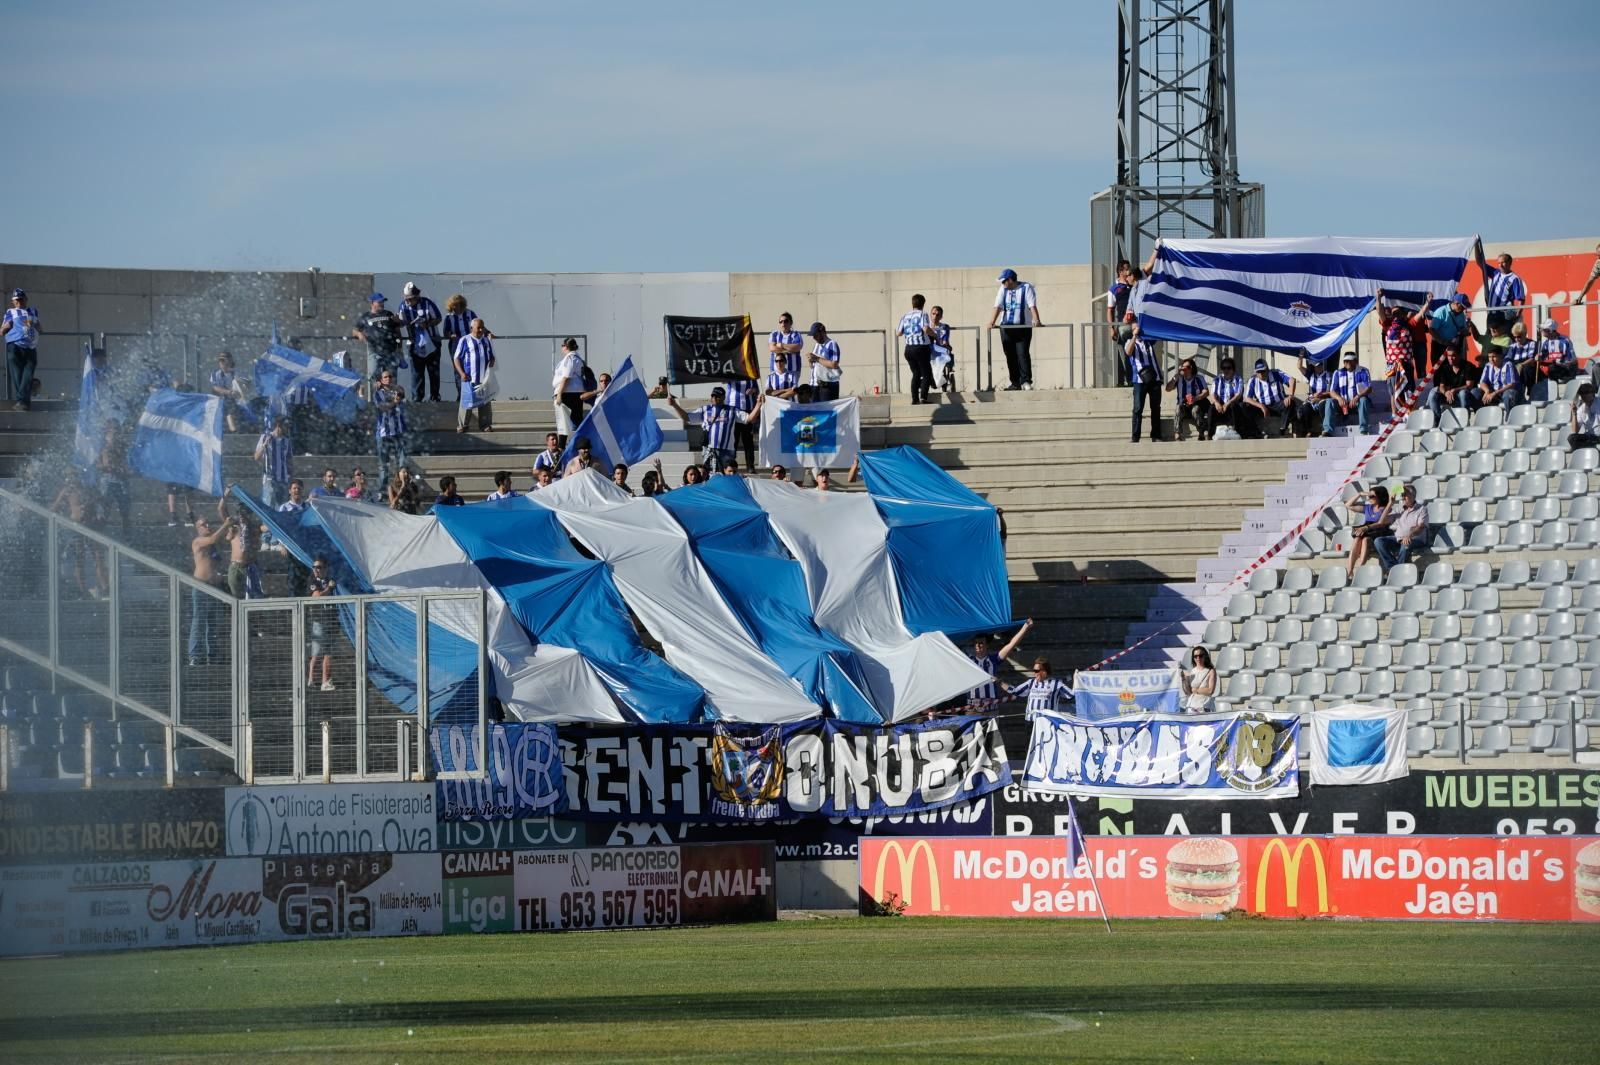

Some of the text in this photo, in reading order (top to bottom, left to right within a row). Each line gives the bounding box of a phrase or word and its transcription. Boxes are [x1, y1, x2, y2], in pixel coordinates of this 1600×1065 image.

[685, 359, 736, 375] VIDA
[1081, 674, 1173, 689] REAL CLUB
[1425, 774, 1600, 808] MUEBLES
[275, 793, 433, 820] Clínica de Fisioterapia
[141, 821, 219, 850] IRANZO
[278, 822, 373, 854] Antonio
[444, 852, 511, 874] CANAL+
[557, 854, 569, 864] EN
[591, 850, 679, 872] PANCORBO
[72, 865, 151, 885] CALZADOS
[683, 868, 772, 898] CANAL+
[147, 861, 262, 922] Mora
[1011, 884, 1097, 912] Jaén
[1405, 884, 1498, 914] Jaén
[278, 880, 375, 936] Gala
[449, 888, 506, 931] Liga
[518, 888, 678, 929] TEL. 953 567 595
